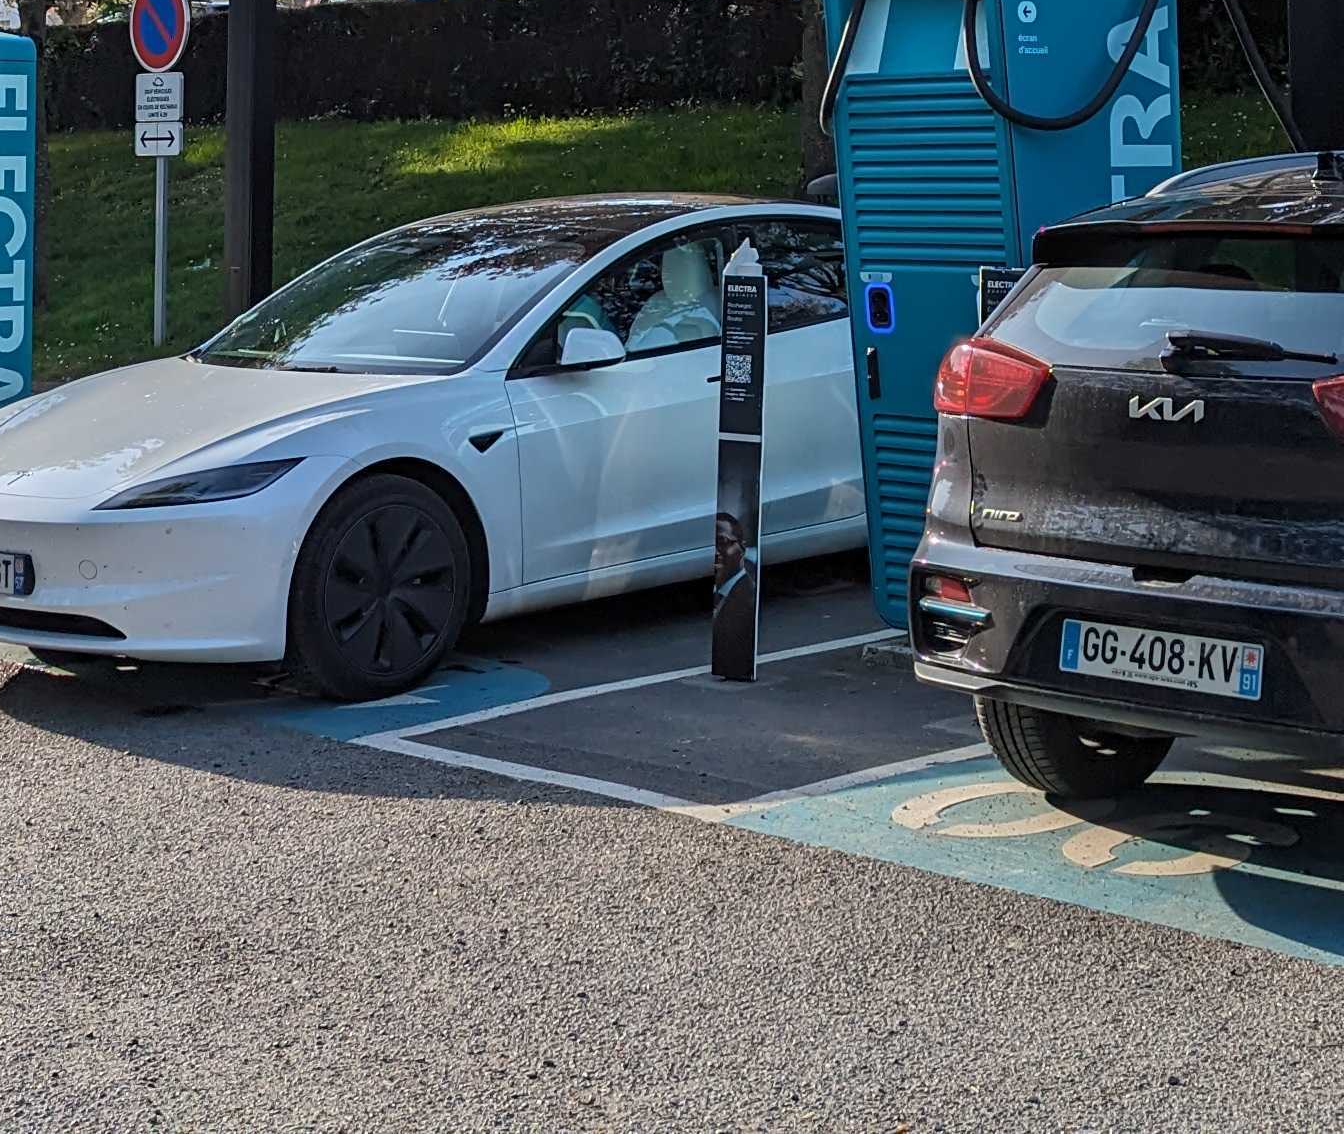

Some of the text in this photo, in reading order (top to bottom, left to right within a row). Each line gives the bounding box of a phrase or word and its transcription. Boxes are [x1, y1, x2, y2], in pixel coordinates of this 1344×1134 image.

[1129, 395, 1204, 423] KIA
[982, 508, 1021, 522] niro
[1066, 649, 1074, 660] F
[1083, 626, 1238, 683] GG-408-KV
[1242, 673, 1257, 691] 91
